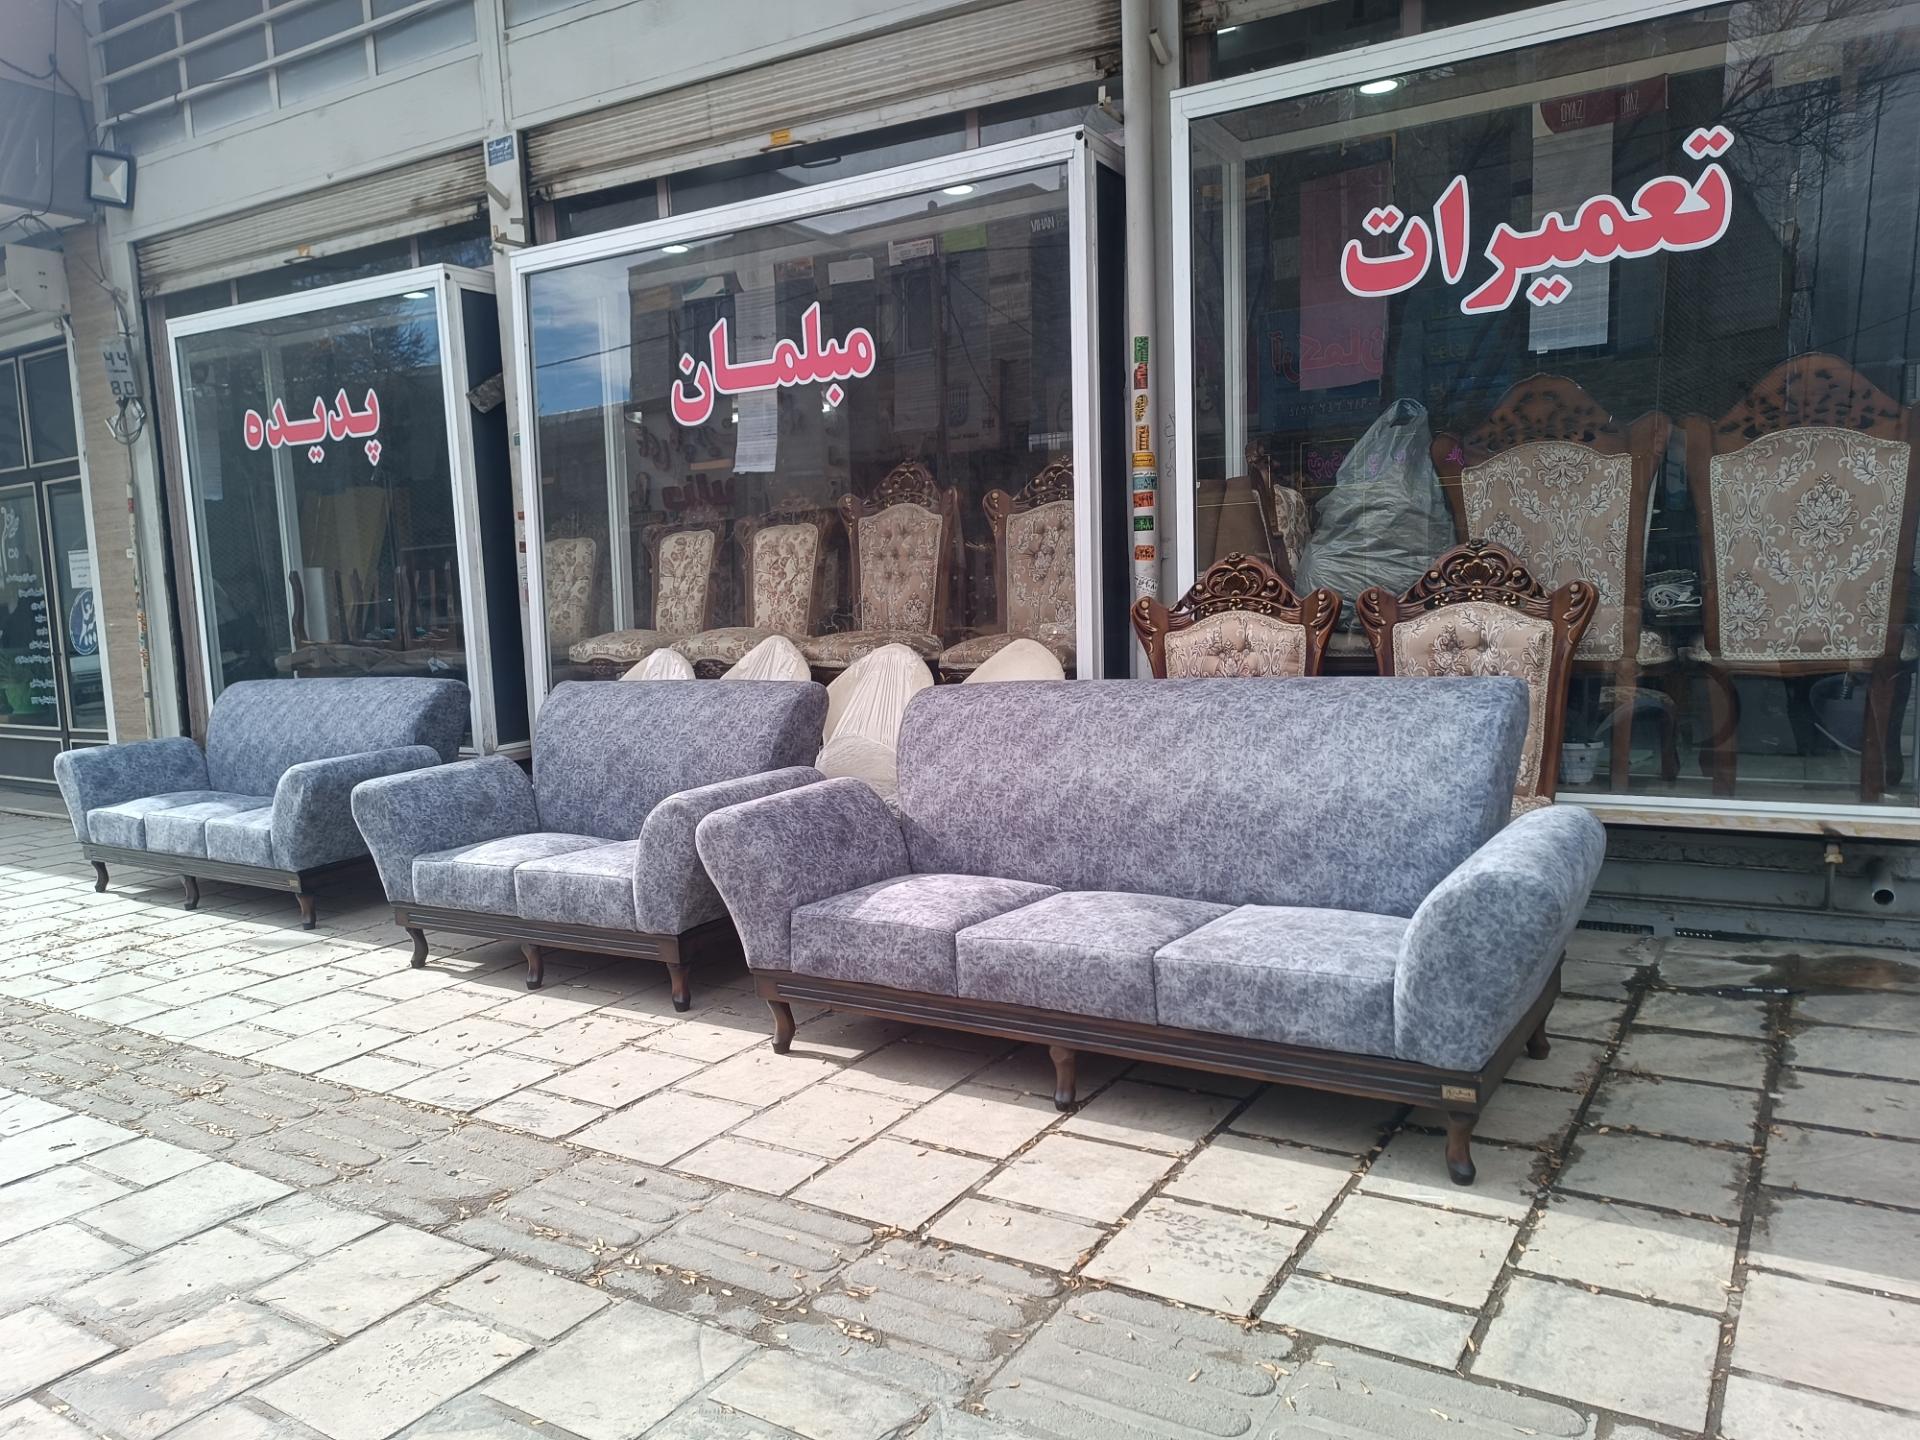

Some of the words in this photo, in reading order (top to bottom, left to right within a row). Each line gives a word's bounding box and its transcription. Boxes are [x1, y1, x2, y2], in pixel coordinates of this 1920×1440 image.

[1340, 124, 1734, 316] تعمیرات
[671, 301, 876, 426] مبلمان
[244, 387, 381, 466] پدیده
